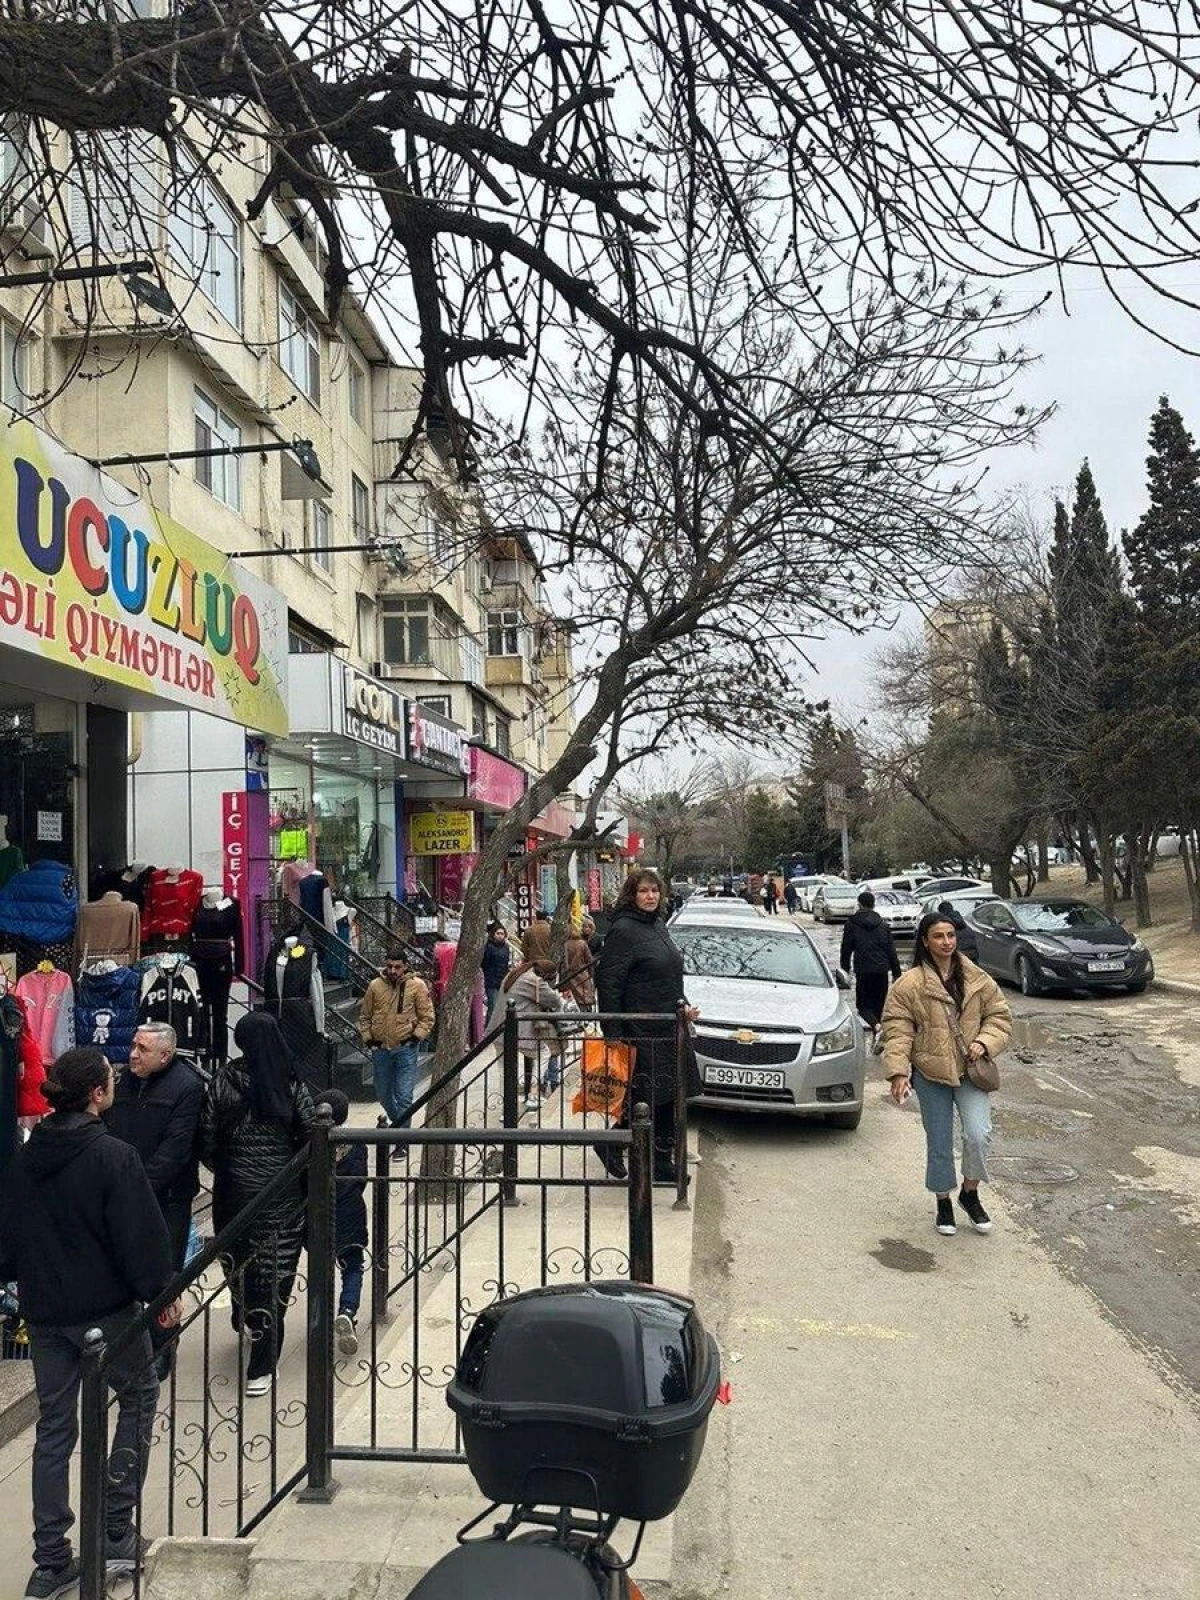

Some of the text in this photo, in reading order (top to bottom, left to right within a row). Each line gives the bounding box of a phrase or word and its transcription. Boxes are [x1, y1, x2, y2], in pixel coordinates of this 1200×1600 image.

[0, 571, 216, 699] ƏLİ QİYMƏTLƏR
[14, 456, 261, 686] UCUZLUQ
[425, 839, 461, 851] LAZER
